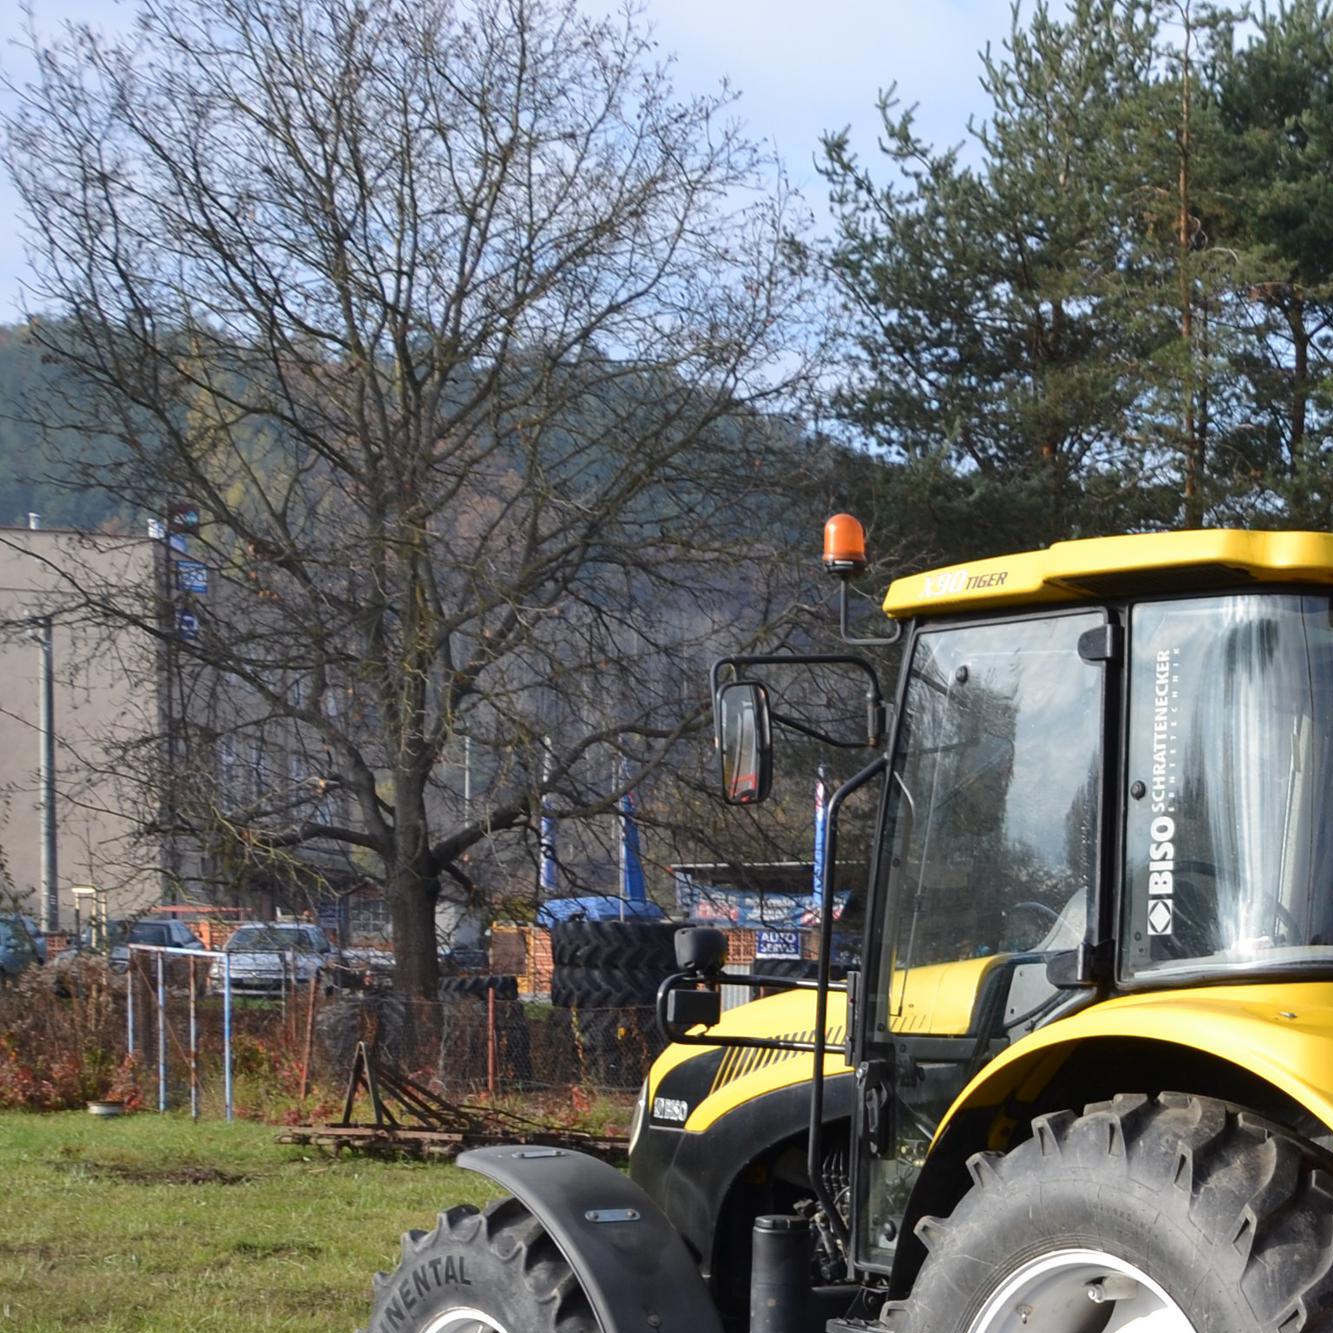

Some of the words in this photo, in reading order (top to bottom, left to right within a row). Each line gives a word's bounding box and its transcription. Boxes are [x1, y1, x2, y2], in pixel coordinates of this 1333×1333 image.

[965, 572, 1008, 590] TIGER
[1151, 649, 1171, 813] SCHRATTENECKER
[1149, 815, 1175, 895] BISO
[761, 932, 796, 943] AUTO
